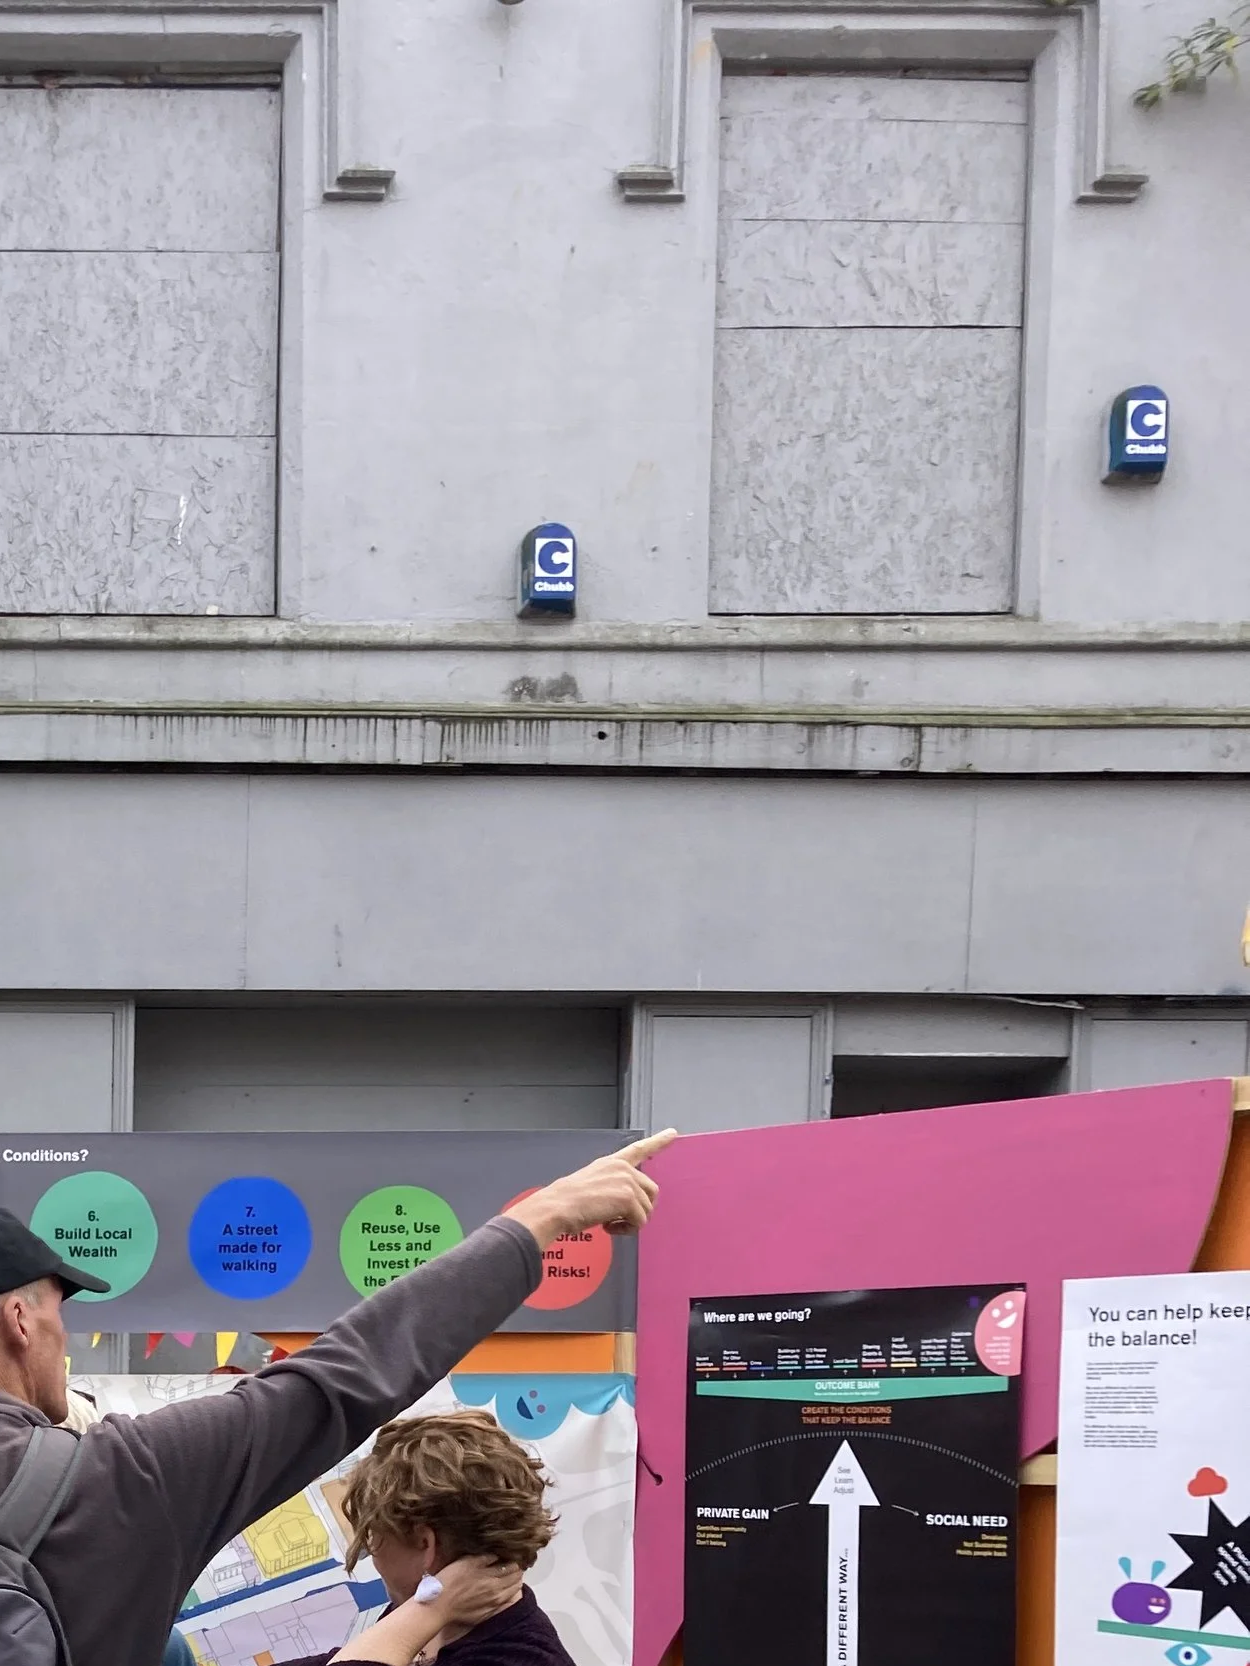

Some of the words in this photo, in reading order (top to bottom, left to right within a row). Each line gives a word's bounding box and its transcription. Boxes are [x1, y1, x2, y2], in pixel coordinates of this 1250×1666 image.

[534, 581, 575, 592] Chubb
[3, 1149, 89, 1162] Conditions?
[88, 1211, 99, 1222] 6.
[246, 1206, 256, 1217] 7.
[395, 1205, 407, 1216] 8.
[54, 1228, 91, 1240] Build
[96, 1228, 132, 1240] Local
[222, 1225, 233, 1236] A
[237, 1224, 278, 1236] street
[361, 1222, 409, 1236] Reuse,
[414, 1222, 440, 1234] Use
[69, 1246, 117, 1258] Wealth
[218, 1242, 257, 1254] made
[262, 1242, 282, 1254] for
[370, 1240, 401, 1252] Less
[405, 1240, 432, 1252] and
[222, 1260, 277, 1274] walking
[367, 1258, 409, 1269] Invest
[547, 1266, 591, 1278] Risks!
[364, 1275, 385, 1287] the
[704, 1310, 735, 1323] Where
[738, 1313, 754, 1322] are
[757, 1313, 773, 1322] we
[774, 1308, 812, 1323] going?
[1089, 1306, 1121, 1323] You
[1126, 1307, 1158, 1321] can
[1164, 1303, 1203, 1322] help
[1088, 1331, 1115, 1348] the
[1121, 1329, 1198, 1347] balance!
[815, 1381, 855, 1390] OUTCOME
[857, 1381, 880, 1389] BANK
[801, 1406, 829, 1414] CREATE
[830, 1406, 845, 1414] THE
[846, 1405, 892, 1414] CONDITIONS
[802, 1416, 819, 1424] THAT
[821, 1416, 841, 1424] KEEP
[842, 1416, 857, 1424] THE
[858, 1416, 891, 1424] BALANCE
[837, 1466, 851, 1474] See
[696, 1506, 740, 1519] PRIVATE
[742, 1508, 770, 1520] GAIN
[926, 1513, 970, 1526] SOCIAL
[972, 1515, 1008, 1527] NEED
[838, 1588, 848, 1661] DIFFERENT
